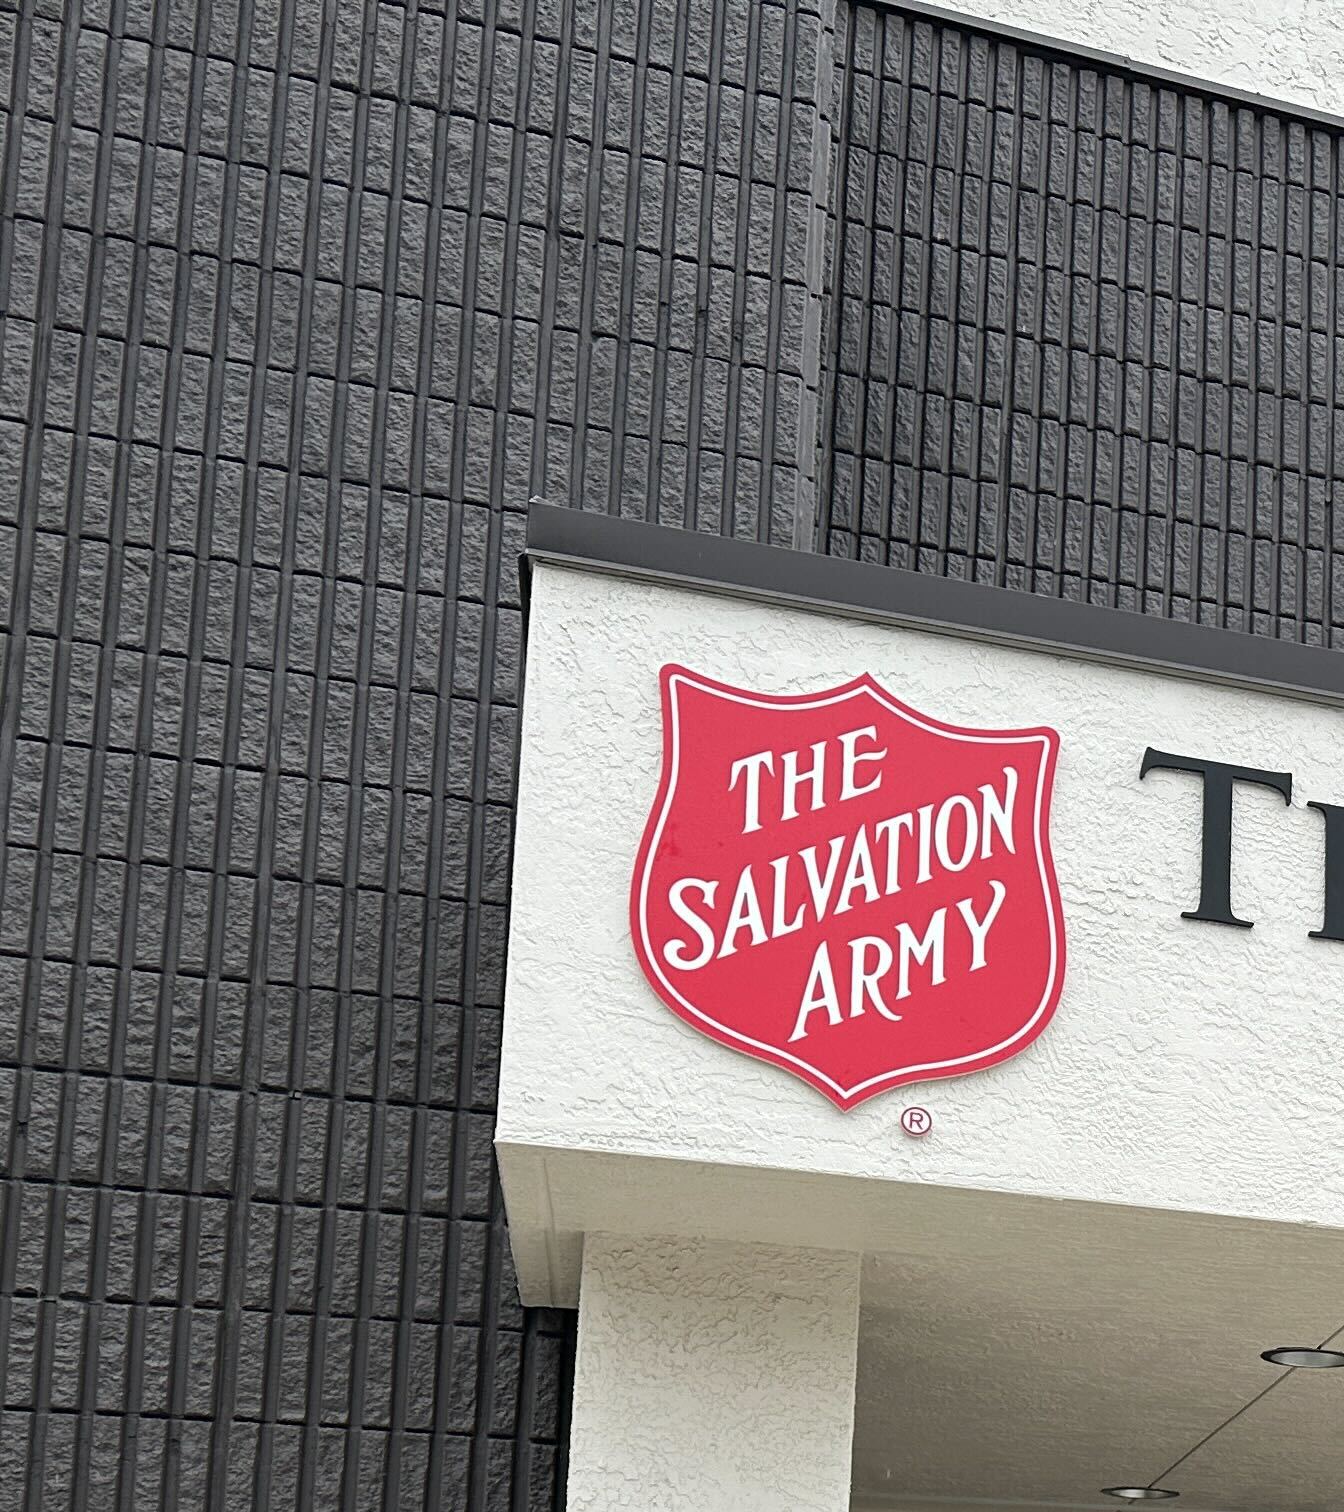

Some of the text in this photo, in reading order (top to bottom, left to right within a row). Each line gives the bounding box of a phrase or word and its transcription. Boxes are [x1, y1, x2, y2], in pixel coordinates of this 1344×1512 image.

[728, 725, 888, 834] THE
[663, 766, 1018, 971] SALVATION
[787, 879, 1006, 1043] ARMY
